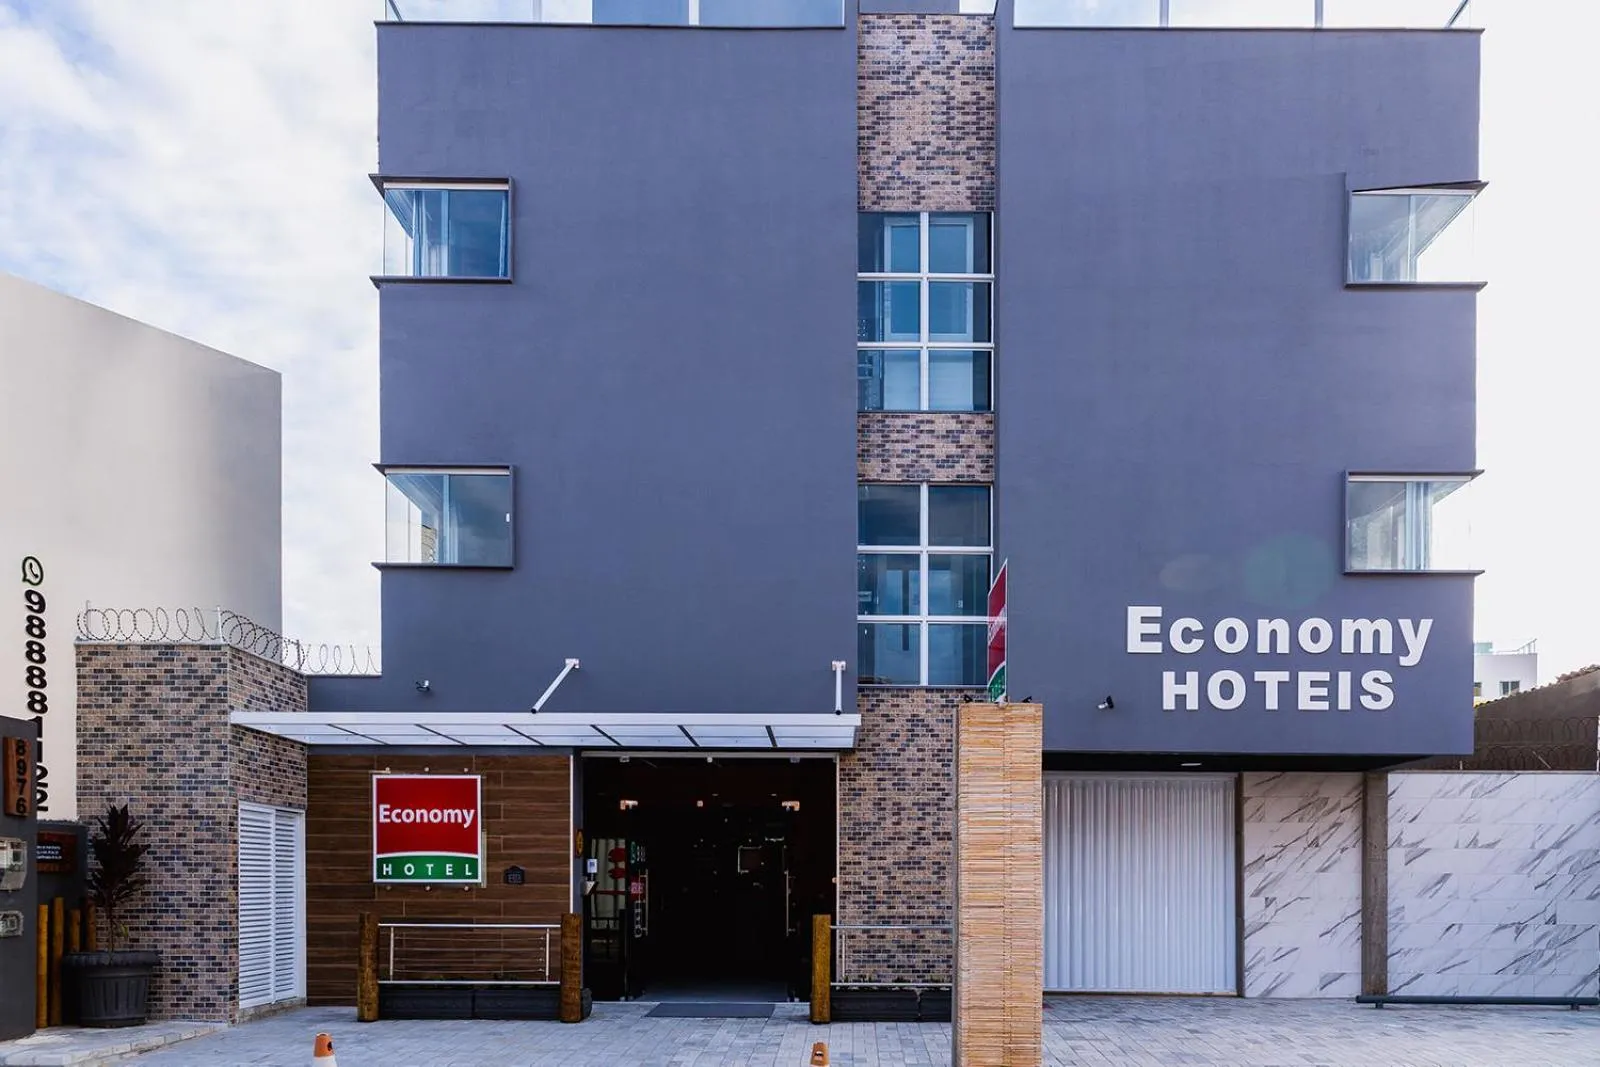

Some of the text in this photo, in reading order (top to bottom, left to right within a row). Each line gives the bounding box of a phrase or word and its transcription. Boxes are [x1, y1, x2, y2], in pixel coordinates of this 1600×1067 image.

[1127, 606, 1433, 666] Economy
[1162, 670, 1394, 711] HOTEIS
[16, 737, 27, 814] 8976
[378, 804, 475, 828] Economy
[382, 863, 472, 876] HOTEL
